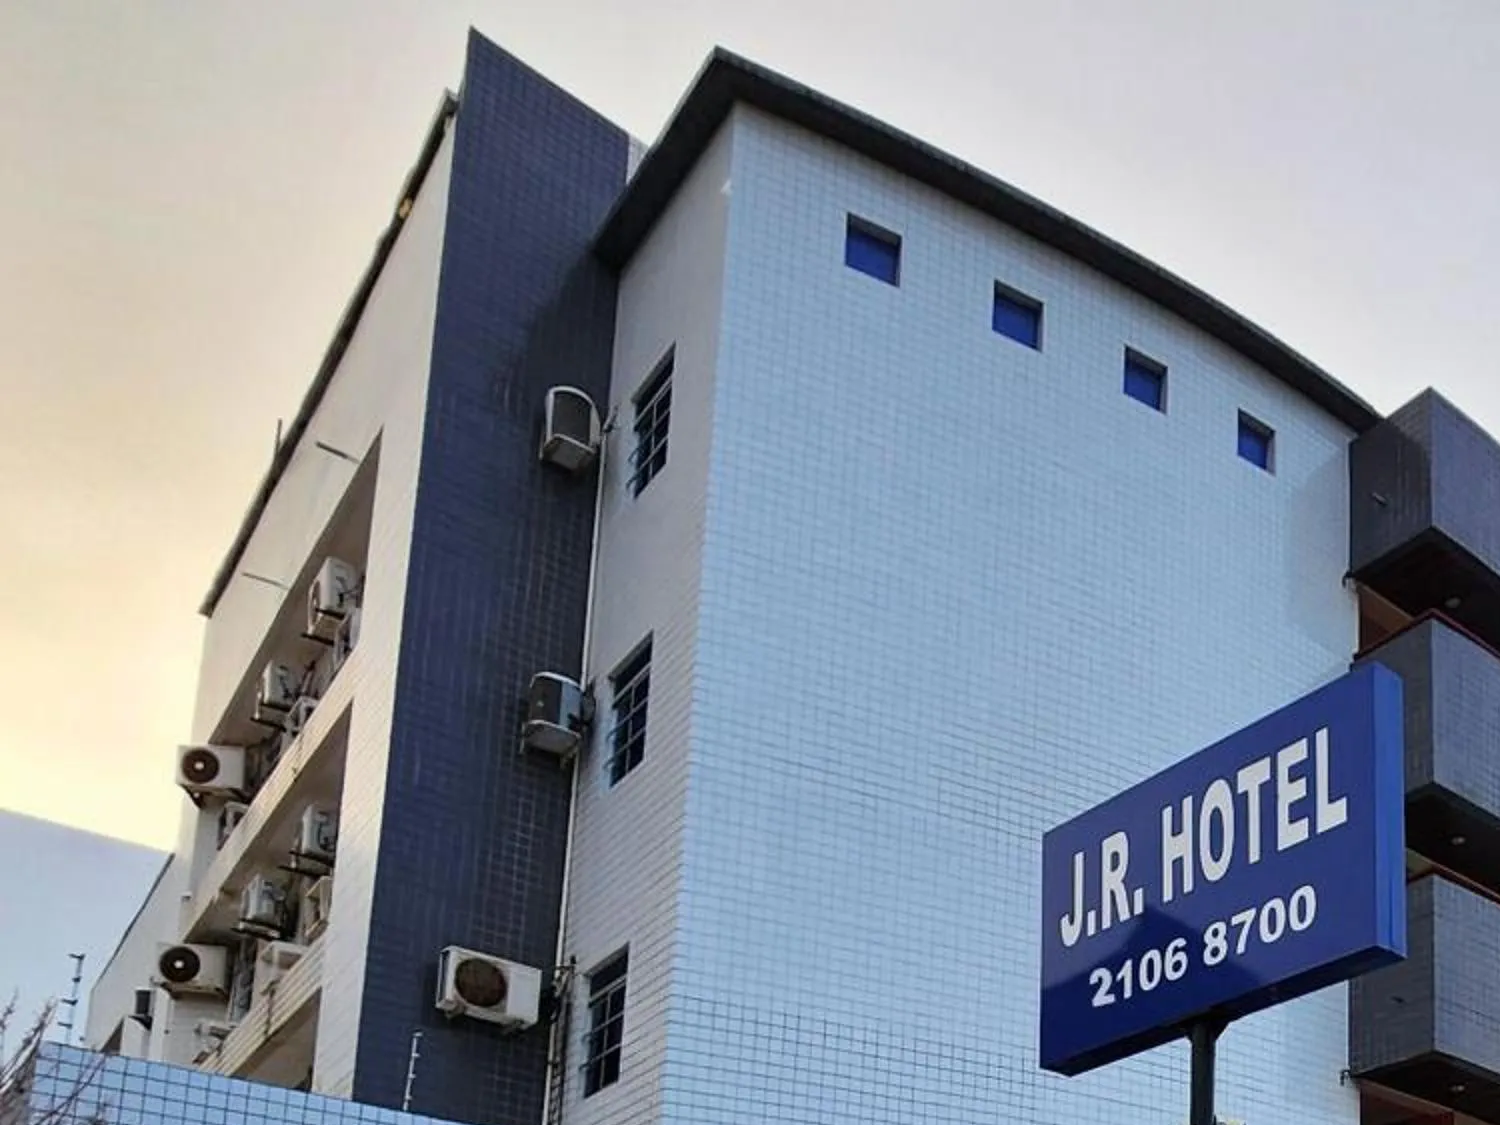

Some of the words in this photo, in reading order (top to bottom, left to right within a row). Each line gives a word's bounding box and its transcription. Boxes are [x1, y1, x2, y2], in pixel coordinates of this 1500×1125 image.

[1059, 830, 1144, 949] J.R.
[1161, 726, 1348, 903] HOTEL
[1089, 937, 1189, 1008] 2106
[1203, 885, 1317, 967] 8700
